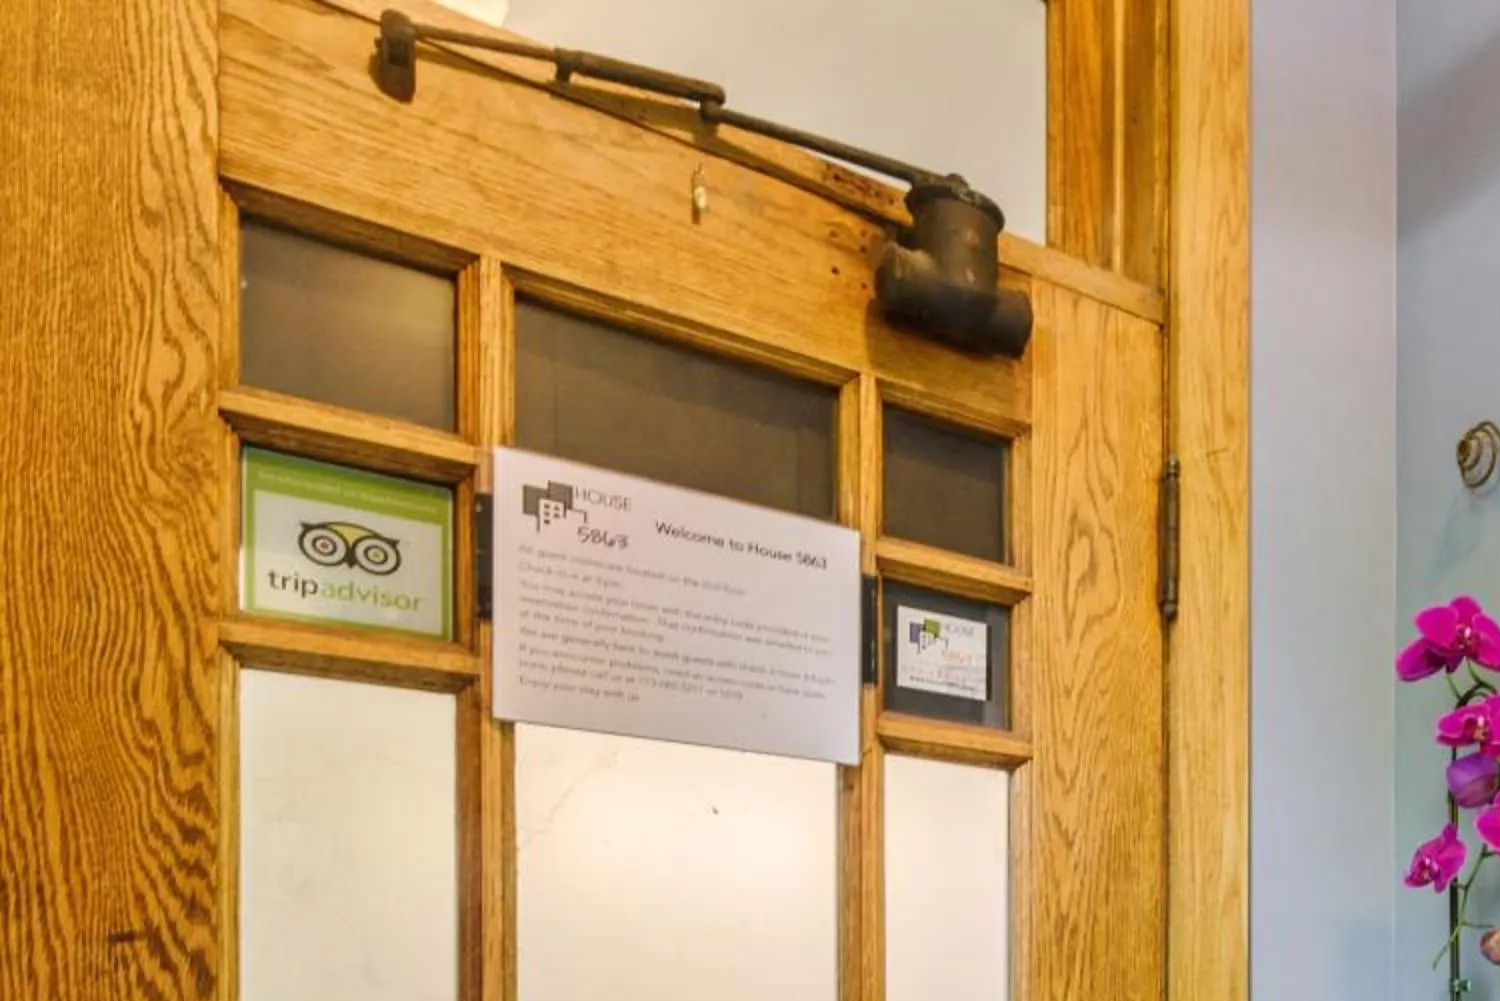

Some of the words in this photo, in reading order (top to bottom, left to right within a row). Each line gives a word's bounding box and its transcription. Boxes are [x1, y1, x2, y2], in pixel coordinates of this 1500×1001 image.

[574, 486, 633, 511] HOUSE
[654, 520, 725, 549] Welcome
[729, 537, 745, 554] to
[748, 542, 793, 563] House
[267, 569, 423, 612] tripadvisor
